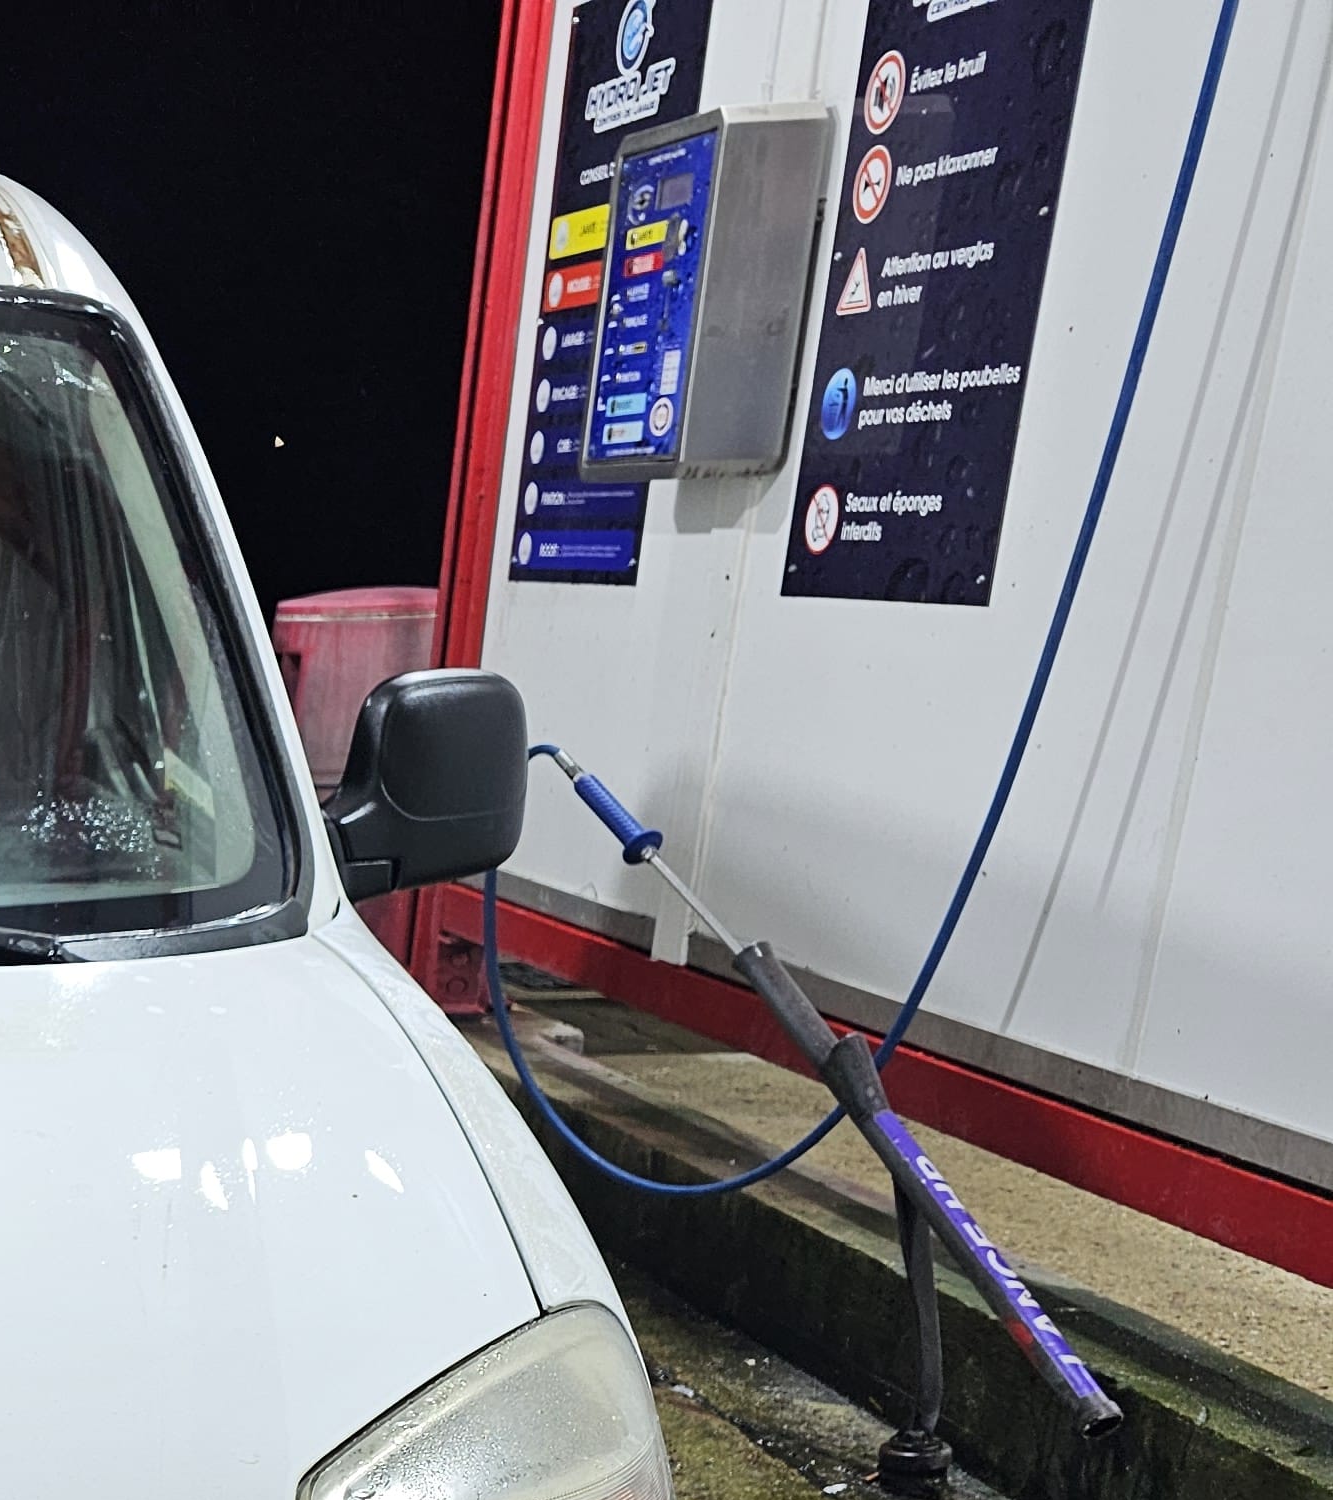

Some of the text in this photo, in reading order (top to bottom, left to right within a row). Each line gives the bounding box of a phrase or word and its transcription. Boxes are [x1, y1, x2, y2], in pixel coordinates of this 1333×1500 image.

[909, 51, 987, 93] Évitez le bruit
[895, 147, 999, 187] Ne pas klaxonner
[880, 240, 995, 278] Attention au verglas
[876, 284, 923, 309] en hiver
[863, 363, 1022, 397] Merci d'utiliser les poubelles
[858, 400, 953, 430] pour vos déchets
[844, 490, 943, 517] Seaux et éponges
[840, 521, 883, 541] interdits
